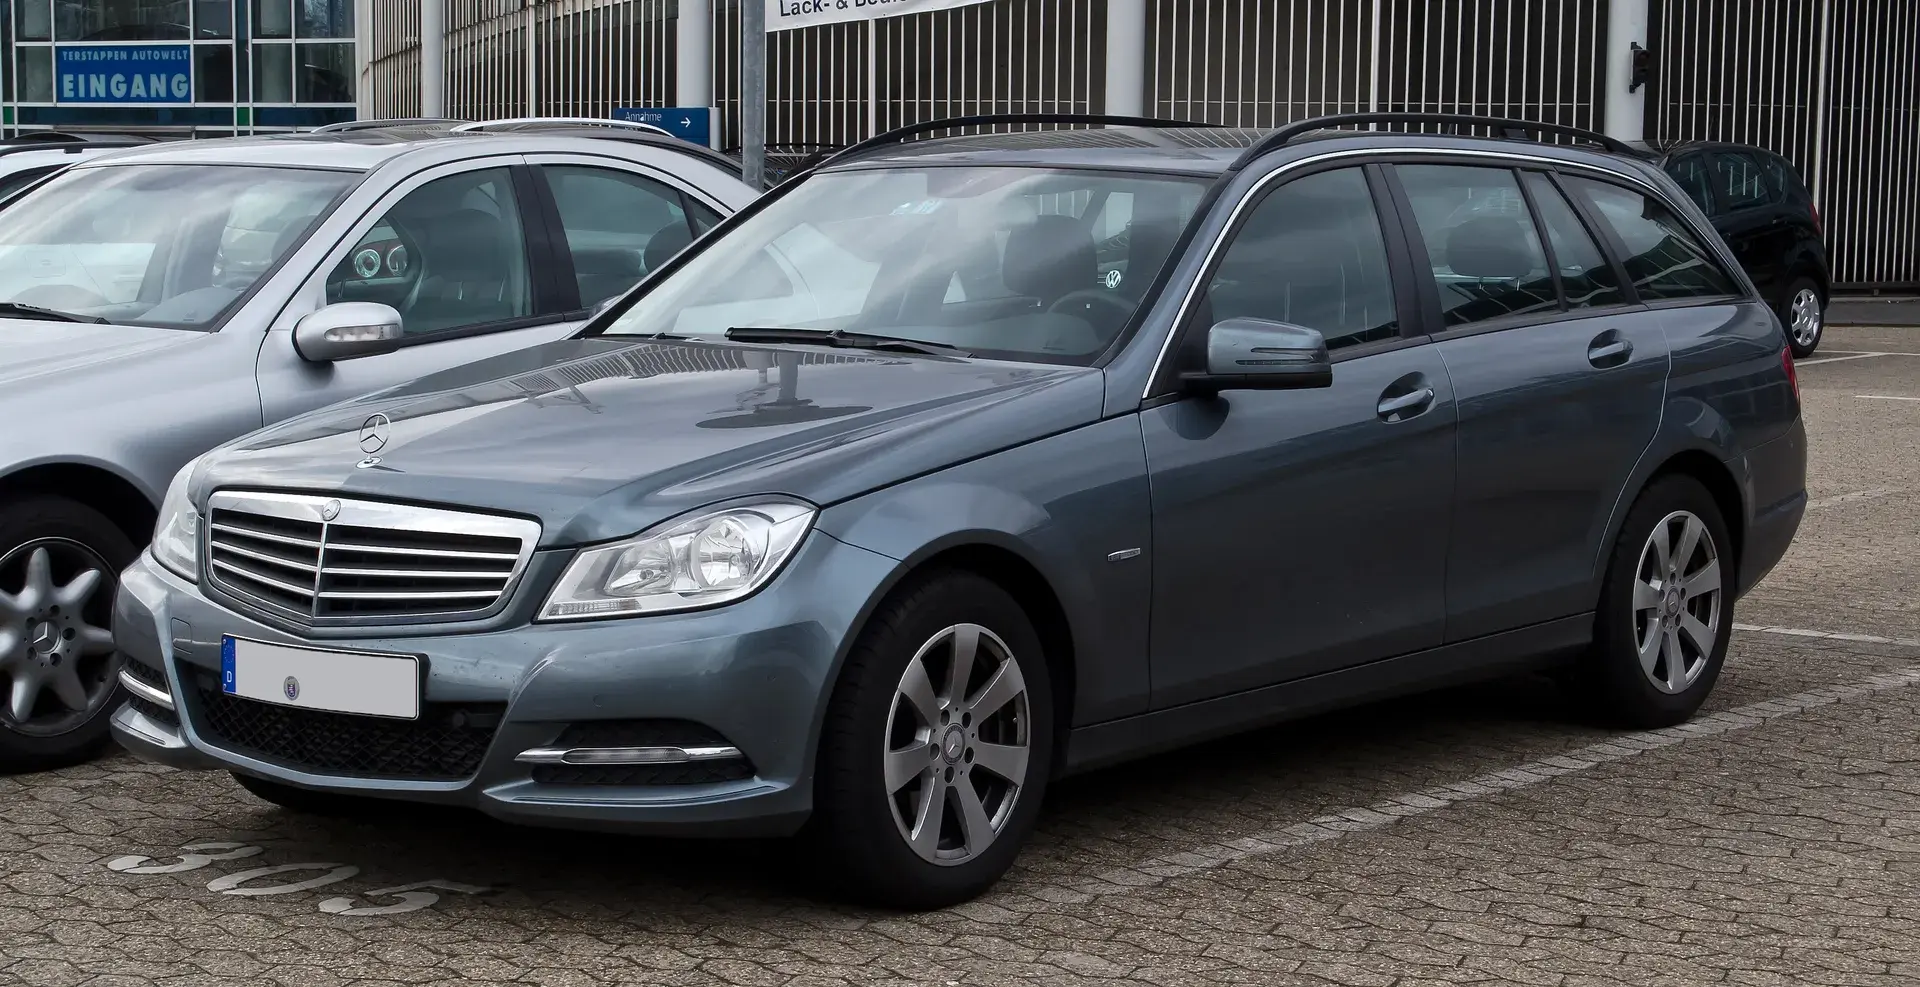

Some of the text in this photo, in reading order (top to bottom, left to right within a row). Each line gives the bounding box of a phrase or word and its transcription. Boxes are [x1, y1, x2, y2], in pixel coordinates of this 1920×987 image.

[780, 0, 830, 17] Lack-
[62, 50, 188, 61] TERSTAPPEN AUTOWELT
[62, 73, 189, 98] EINGANG
[624, 111, 662, 122] Annahme
[226, 670, 233, 683] D
